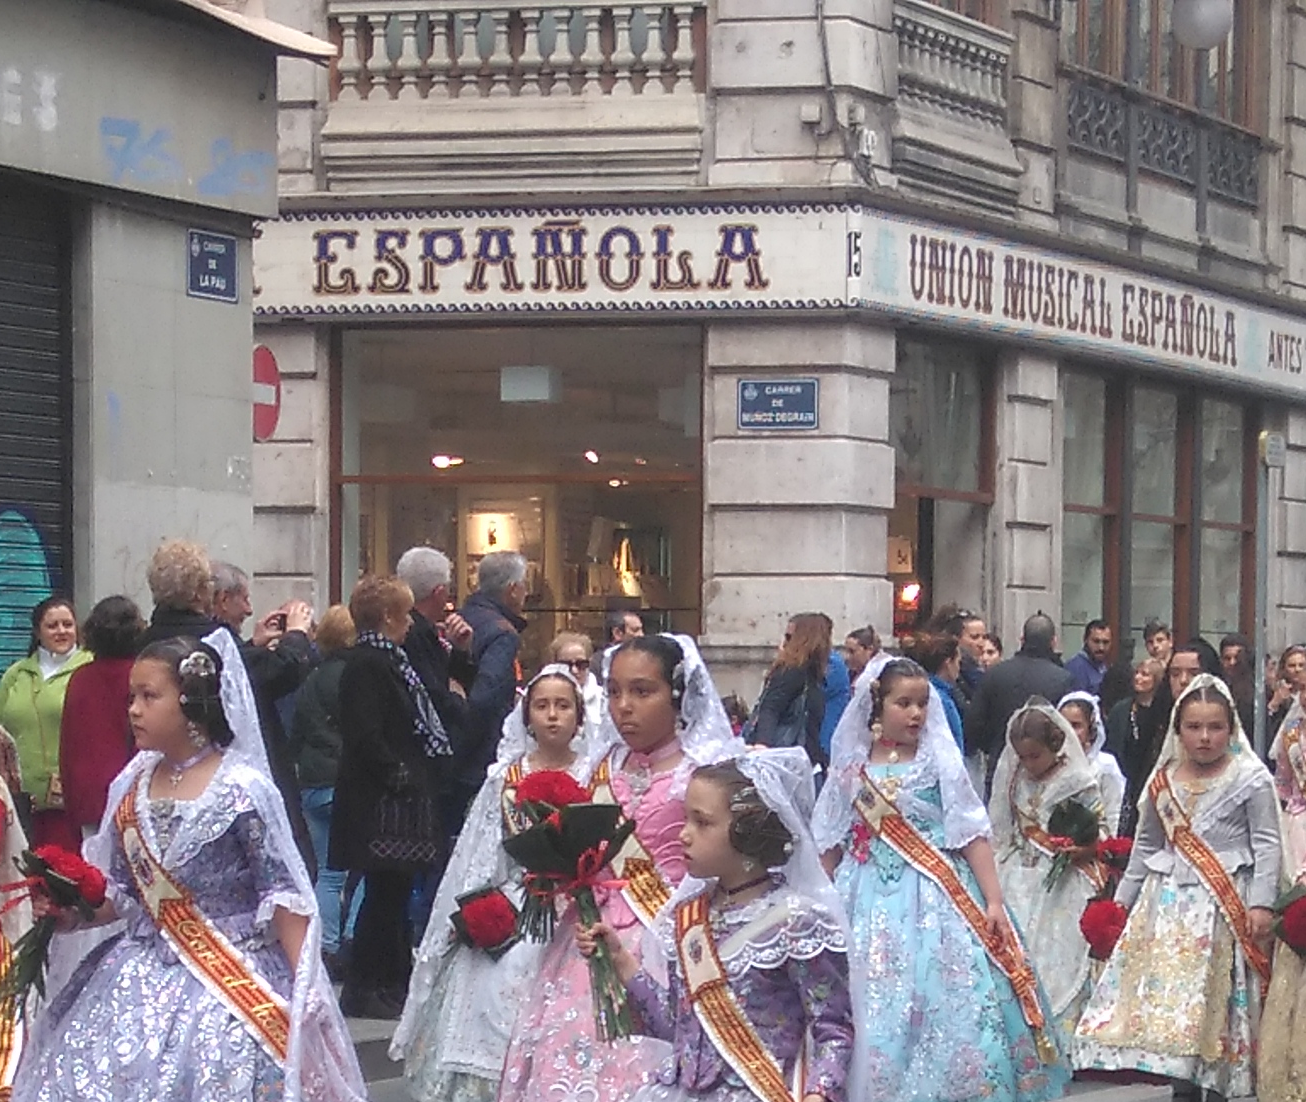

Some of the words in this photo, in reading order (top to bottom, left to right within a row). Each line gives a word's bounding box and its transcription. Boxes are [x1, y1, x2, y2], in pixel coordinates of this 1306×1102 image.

[312, 220, 771, 295] ESPAÑOLA
[846, 231, 862, 278] 15
[199, 274, 209, 287] LA
[210, 275, 226, 291] PAU
[909, 233, 995, 315] UNION
[1002, 254, 1113, 339] MUSICAL
[1120, 283, 1238, 368] ESPAÑOLA
[1267, 330, 1302, 374] ANTES
[765, 385, 802, 396] CARRER
[771, 398, 784, 408] DE
